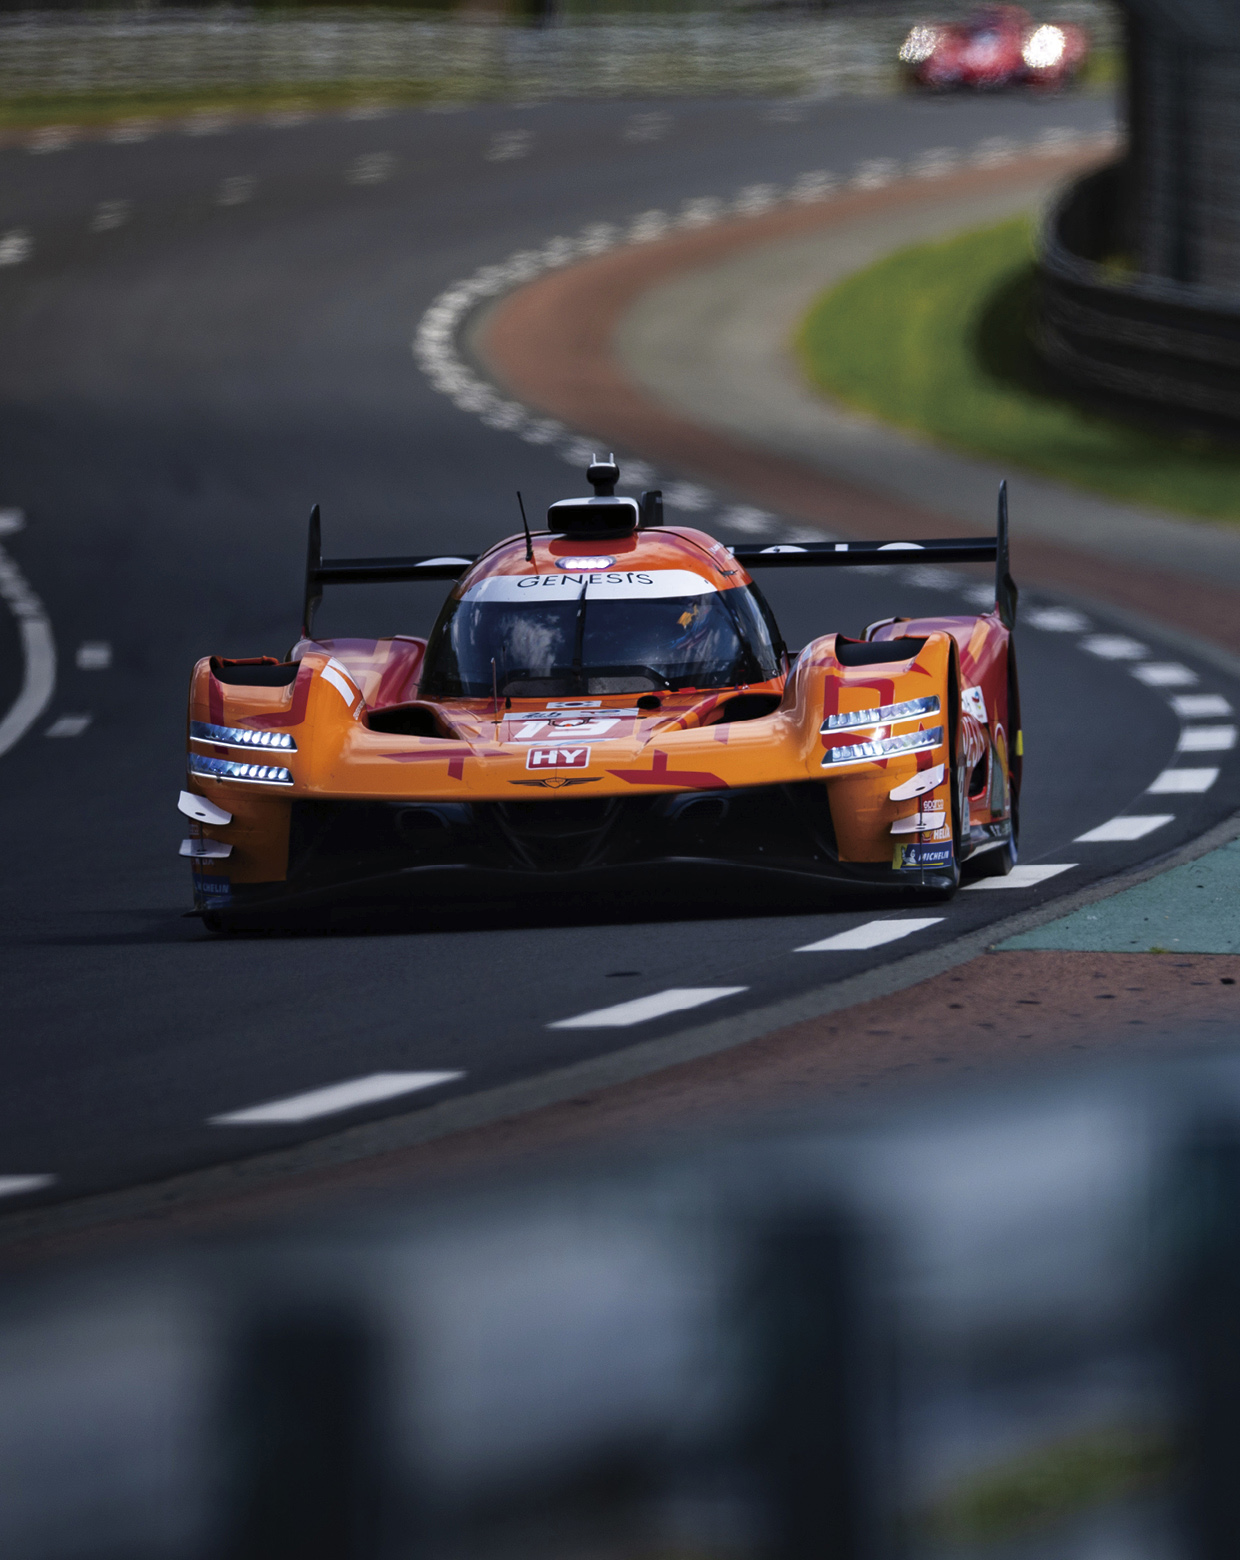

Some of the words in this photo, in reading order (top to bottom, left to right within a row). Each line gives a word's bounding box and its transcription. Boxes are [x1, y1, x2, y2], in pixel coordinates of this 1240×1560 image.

[517, 573, 653, 588] GENESIS
[513, 718, 622, 738] 19
[532, 749, 585, 765] HY
[918, 850, 949, 861] MICHELIN
